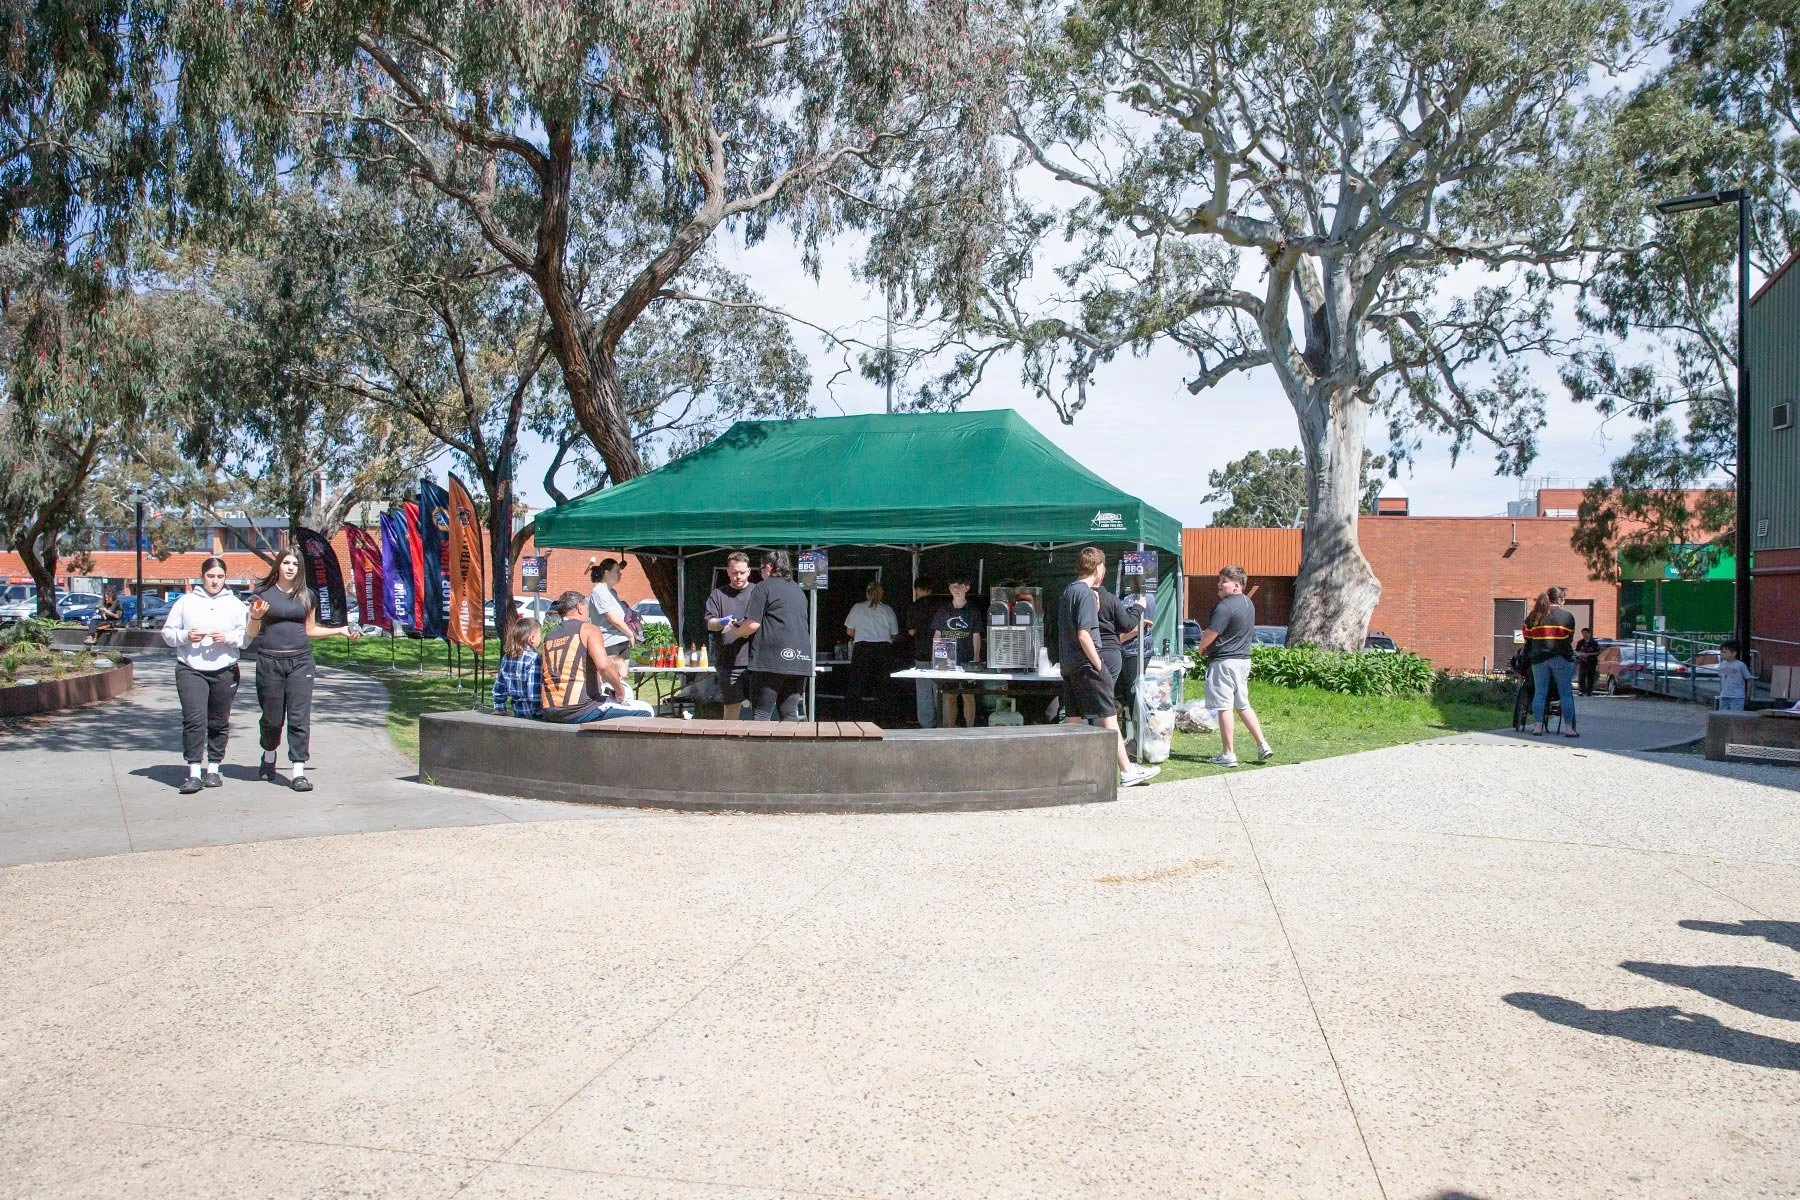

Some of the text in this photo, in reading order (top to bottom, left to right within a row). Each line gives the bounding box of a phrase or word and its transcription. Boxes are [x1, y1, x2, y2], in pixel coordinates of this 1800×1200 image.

[459, 534, 471, 597] BSKETBAL
[314, 560, 332, 620] MERNDA BULLS
[365, 572, 373, 599] MORANG
[394, 583, 406, 616] EPPING
[366, 600, 374, 620] SOUTH
